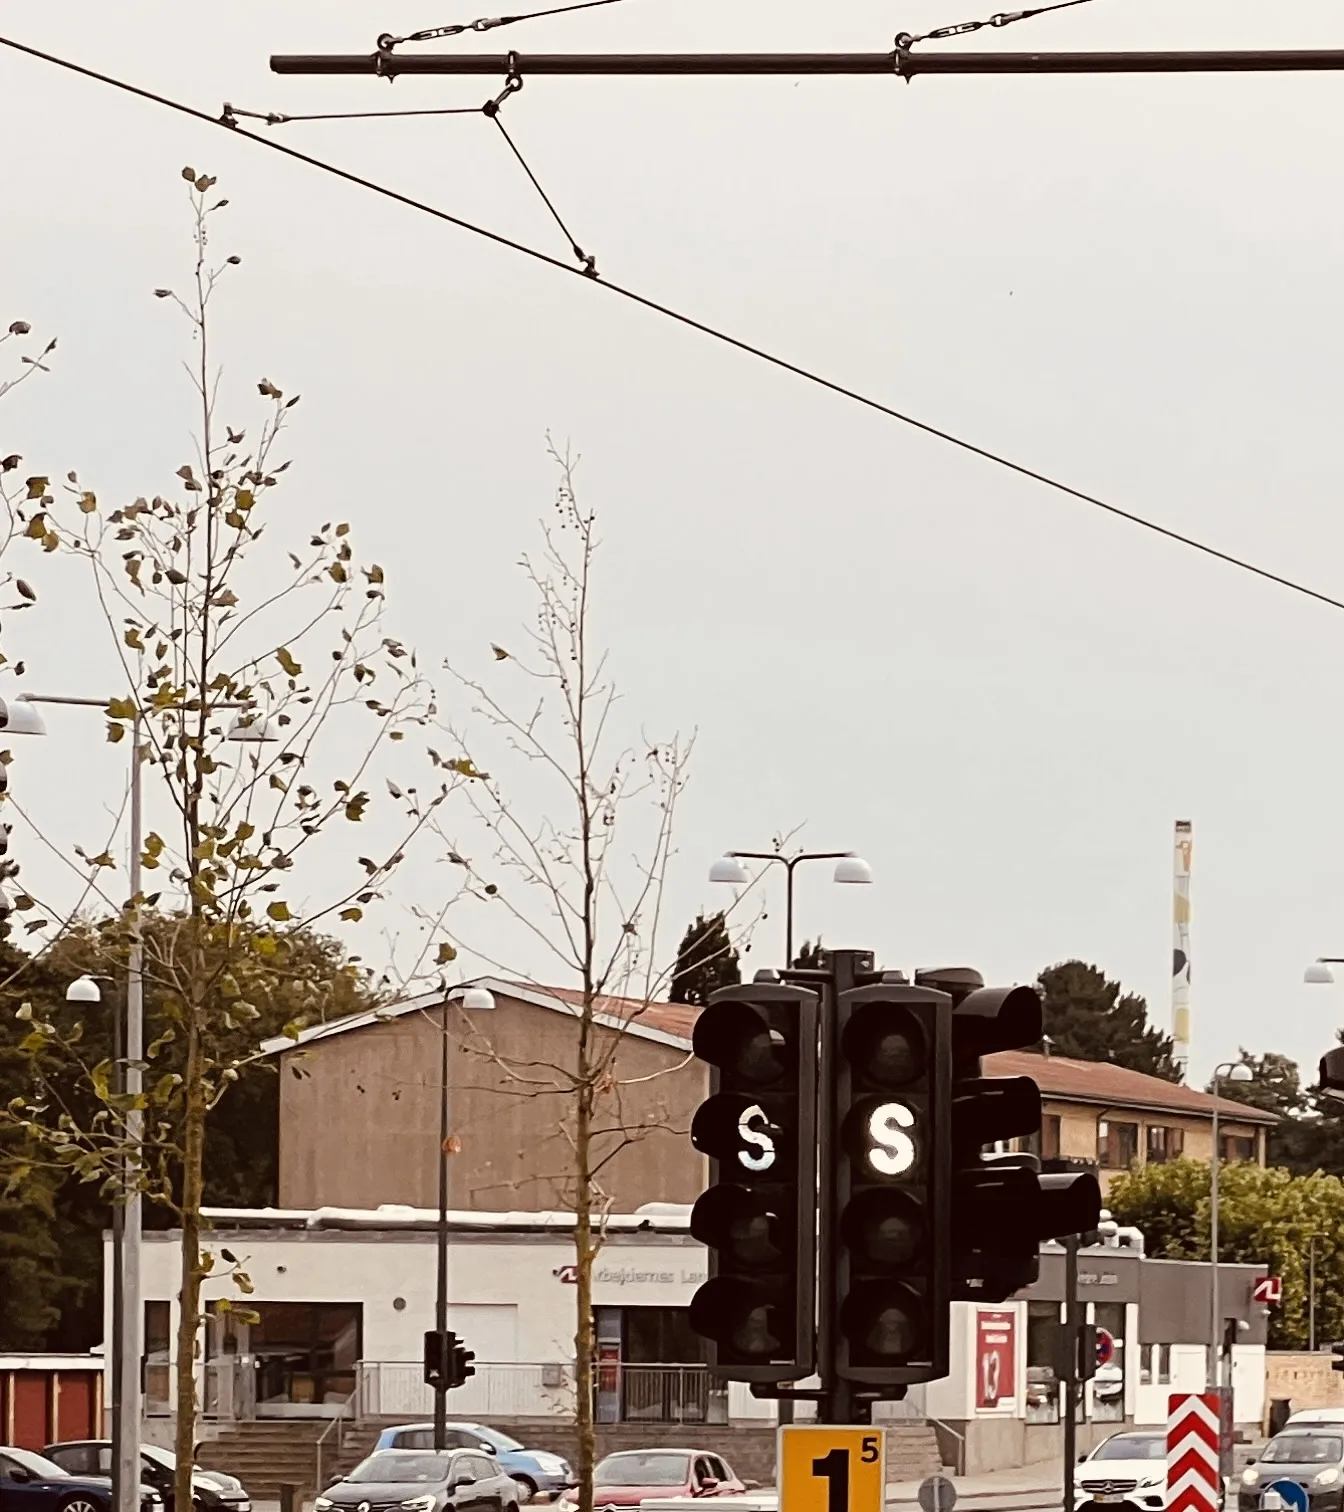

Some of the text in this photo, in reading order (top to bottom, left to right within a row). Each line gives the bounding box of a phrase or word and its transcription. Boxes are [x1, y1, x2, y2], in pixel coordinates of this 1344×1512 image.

[738, 1104, 776, 1171] S
[869, 1102, 915, 1175] S
[860, 1437, 879, 1463] 5
